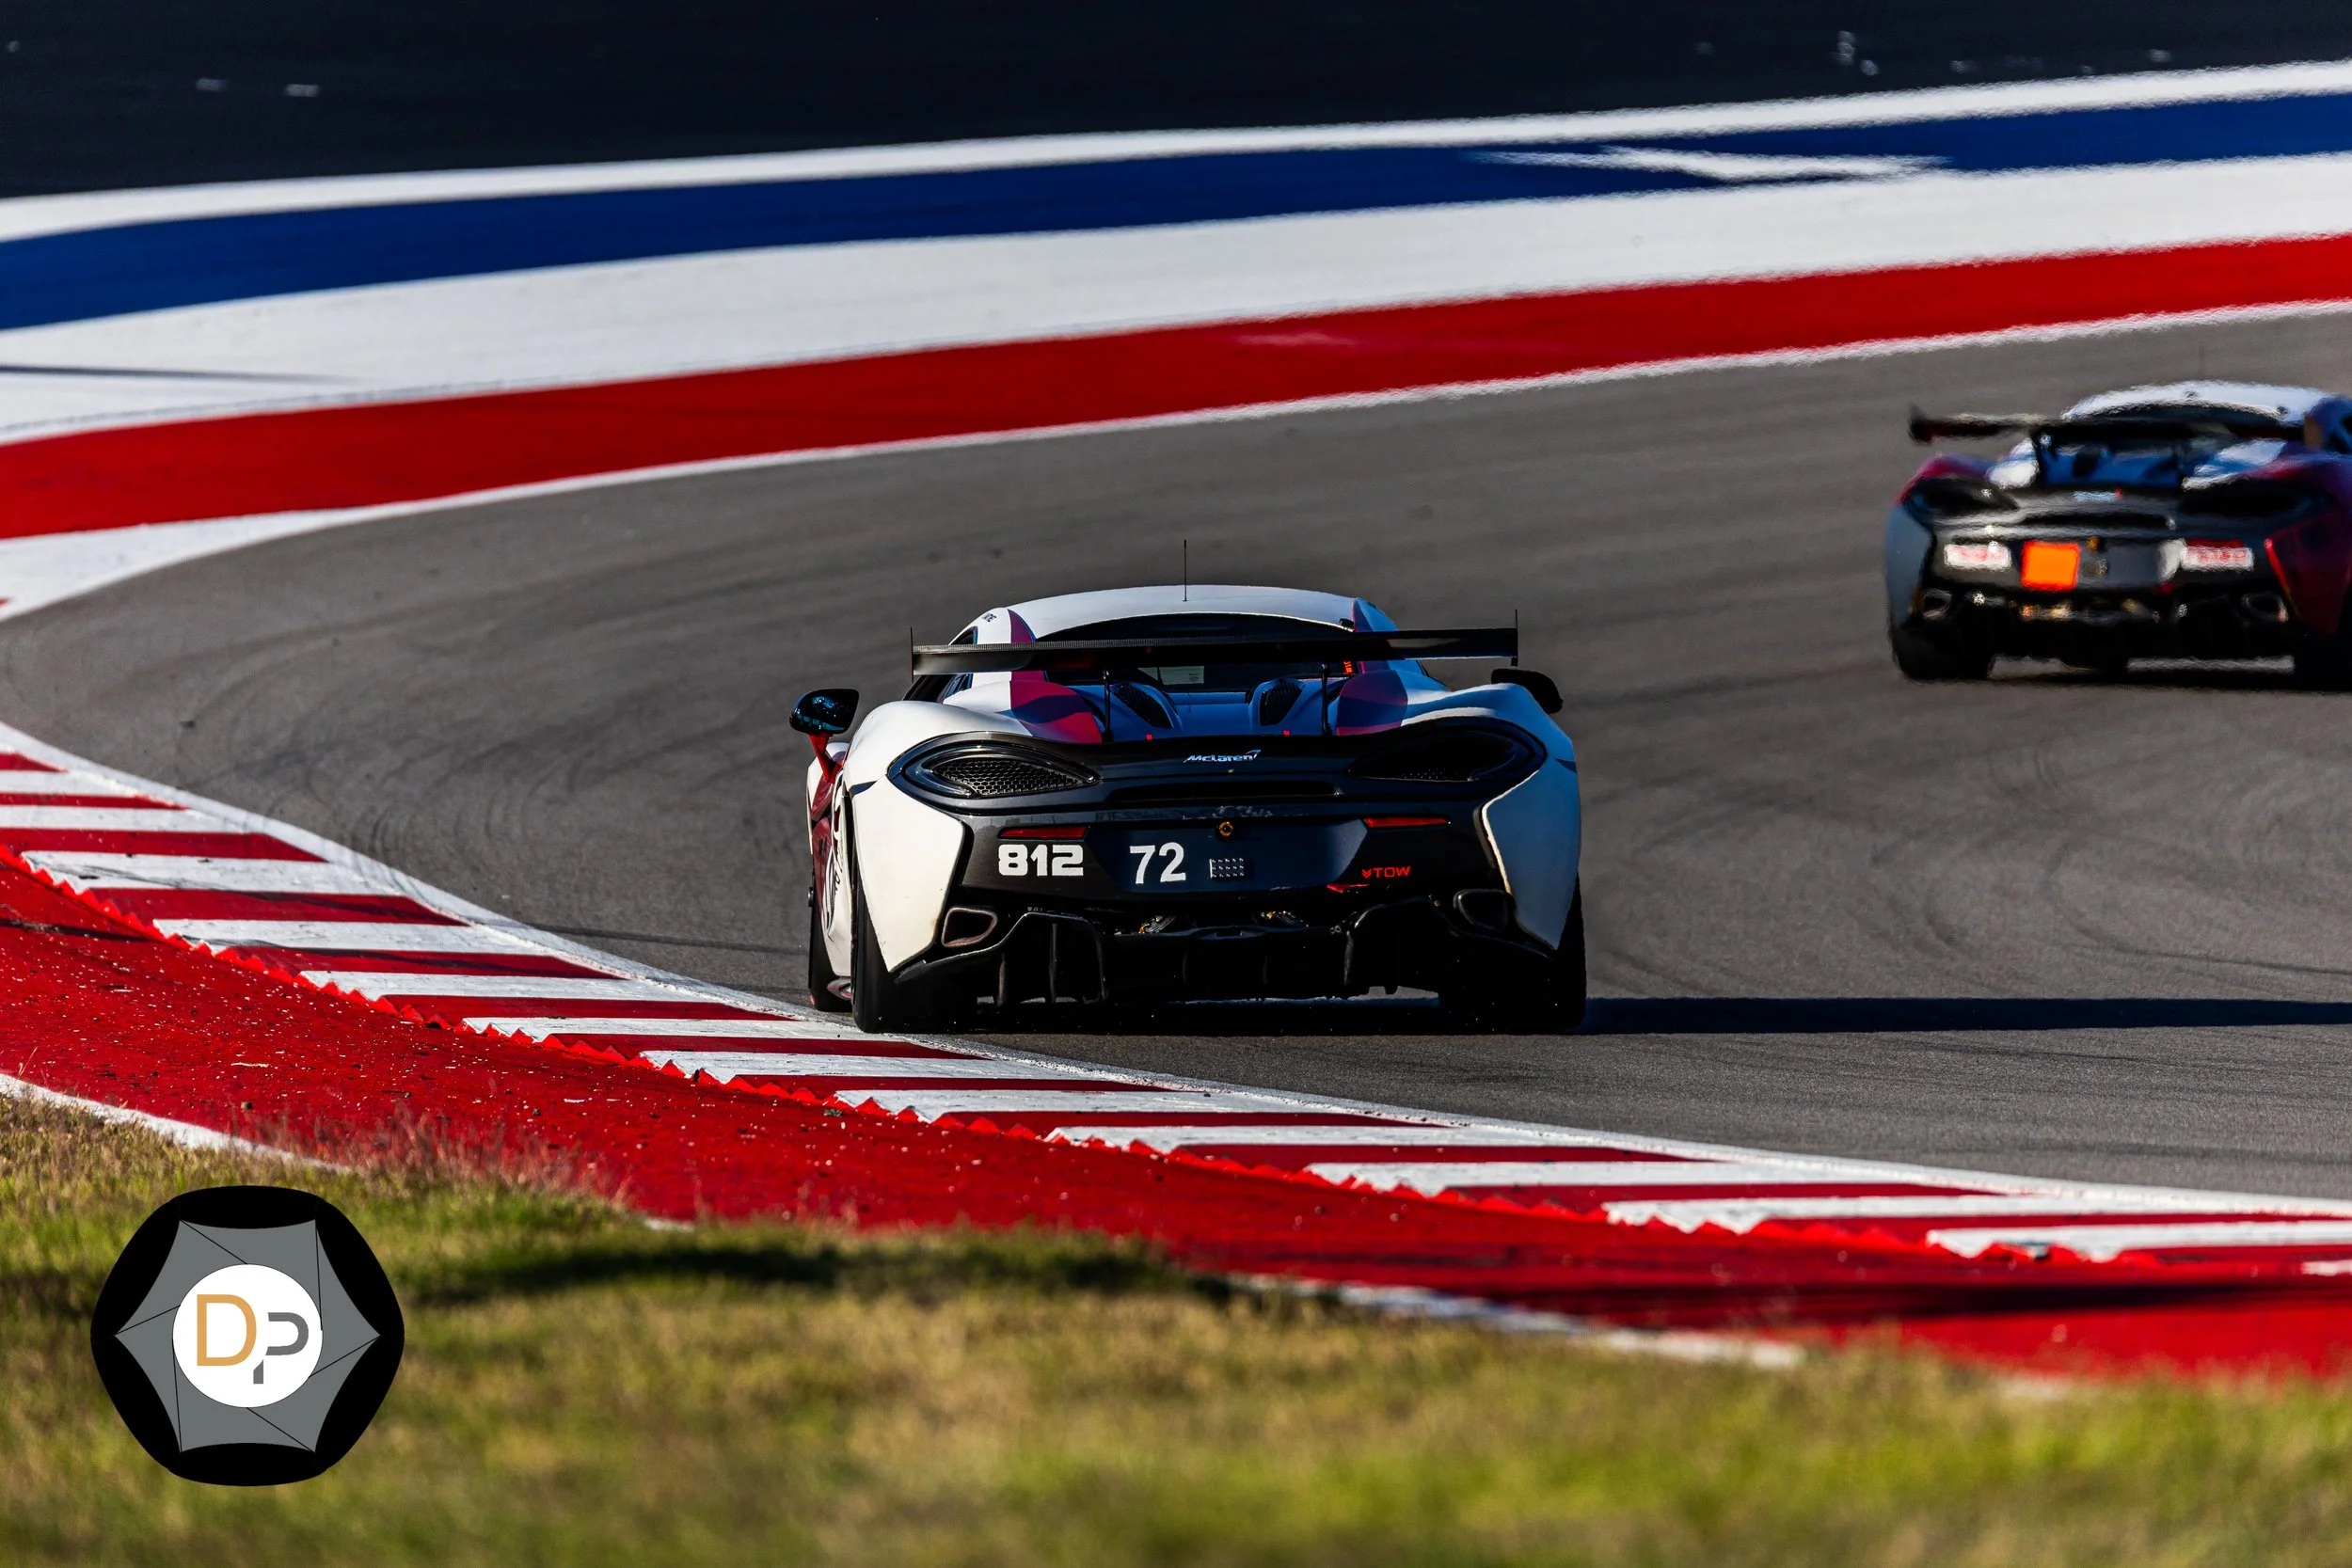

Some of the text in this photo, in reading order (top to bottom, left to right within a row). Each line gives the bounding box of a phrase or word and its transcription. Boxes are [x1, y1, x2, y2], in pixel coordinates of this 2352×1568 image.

[1184, 752, 1256, 763] McLaren
[998, 844, 1084, 876] 812
[1130, 842, 1186, 884] 72
[1373, 865, 1411, 879] TOW
